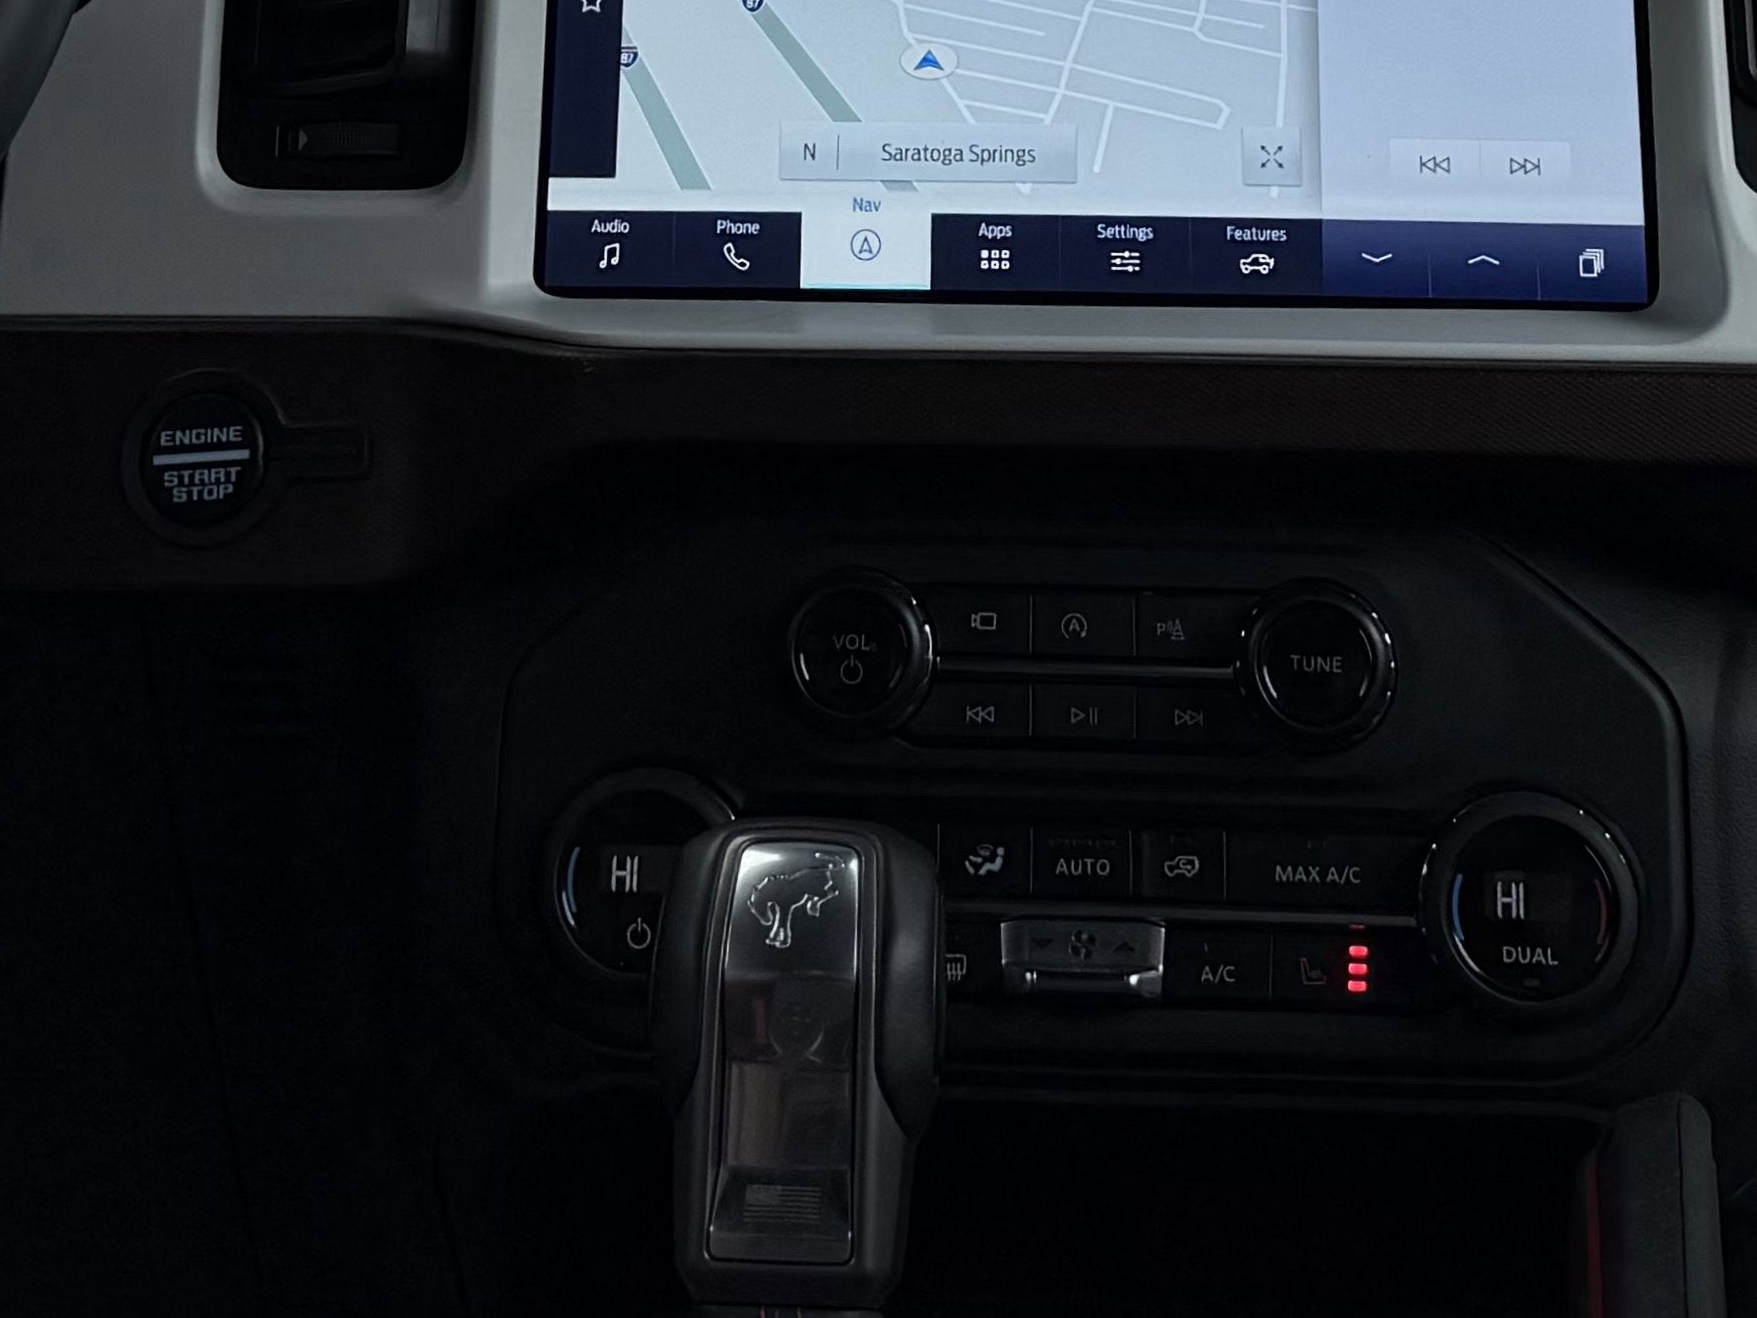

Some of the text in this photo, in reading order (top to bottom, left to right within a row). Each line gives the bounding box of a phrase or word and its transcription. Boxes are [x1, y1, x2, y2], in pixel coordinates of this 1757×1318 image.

[803, 143, 817, 162] N
[881, 143, 1037, 167] Saratoga Springs
[852, 197, 882, 214] Nav
[590, 218, 630, 235] Audio
[715, 218, 761, 235] Phone
[978, 222, 1013, 243] Apps
[1096, 223, 1154, 243] Settings
[1226, 225, 1288, 243] Features
[160, 426, 243, 447] ENGINE
[163, 467, 242, 487] START
[172, 483, 234, 503] STOP
[1290, 654, 1344, 674] TUNE
[611, 854, 639, 893] HI
[1056, 858, 1111, 878] AUTO
[1274, 864, 1362, 886] MAX A/C
[1496, 881, 1526, 920] HI
[1502, 946, 1559, 966] DUAL
[1200, 964, 1236, 984] A/C
